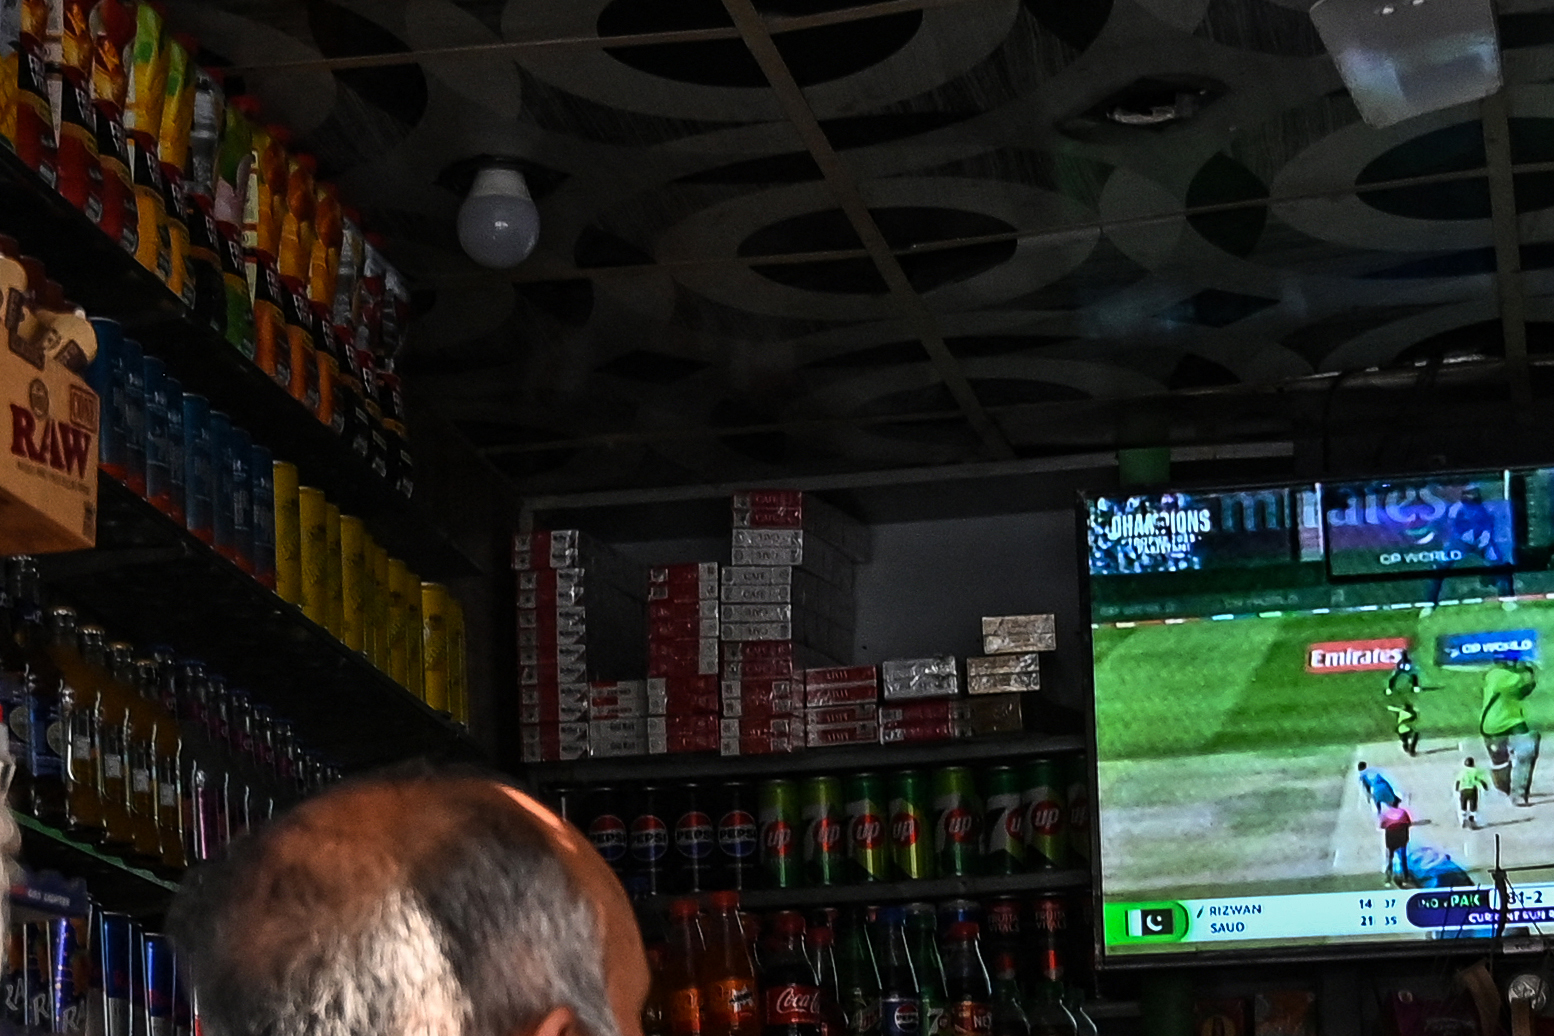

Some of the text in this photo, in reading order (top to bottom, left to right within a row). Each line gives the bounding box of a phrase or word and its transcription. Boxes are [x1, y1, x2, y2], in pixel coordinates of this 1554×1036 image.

[10, 403, 91, 479] RAW
[1404, 550, 1462, 563] WORLD
[1309, 647, 1401, 668] Emirates
[1209, 904, 1262, 917] RIZWAN
[1358, 899, 1372, 909] 14
[1451, 894, 1480, 907] PAK
[1360, 915, 1373, 926] 21
